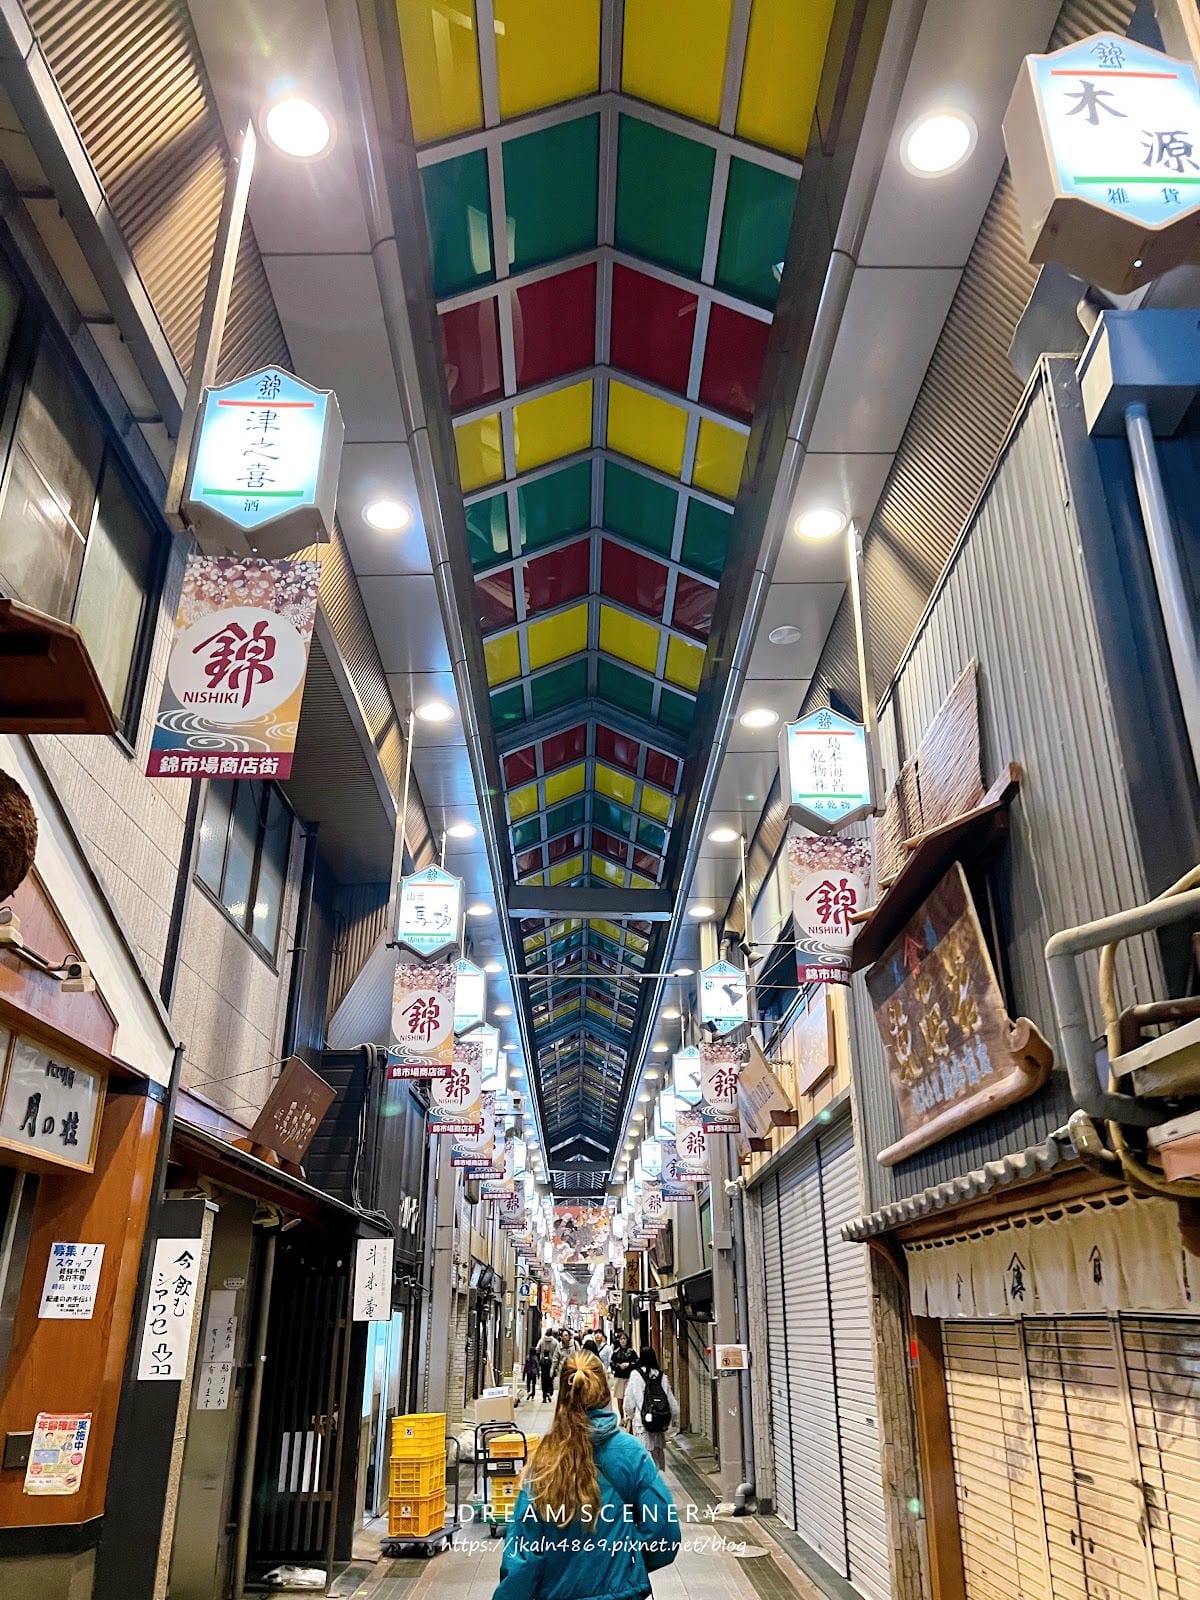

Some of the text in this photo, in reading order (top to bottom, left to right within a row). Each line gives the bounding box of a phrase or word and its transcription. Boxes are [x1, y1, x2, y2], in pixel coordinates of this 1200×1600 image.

[1090, 42, 1126, 69] 錦
[1064, 79, 1200, 173] 木源
[1108, 188, 1182, 205] 雑貨
[255, 374, 281, 400] 錦
[236, 409, 281, 489] 津之喜
[243, 498, 260, 513] 酒
[192, 619, 277, 709] 錦
[183, 690, 239, 704] NISHIKI
[159, 755, 279, 775] 錦市場商店街
[805, 878, 857, 937] 錦
[808, 926, 843, 935] NISHIKI
[402, 996, 440, 1043] 錦
[399, 1034, 426, 1042] NISHIKI
[392, 1067, 446, 1078] 錦市場商店街
[440, 1067, 470, 1105] 錦
[708, 1067, 738, 1105] 錦
[432, 1125, 476, 1133] 錦市場商店街
[682, 1131, 706, 1160] 錦
[56, 1258, 92, 1268] スタッフ
[172, 1250, 194, 1318] 今飲む
[149, 1273, 168, 1336] シアワセ
[149, 1364, 172, 1375] ココ
[38, 1420, 77, 1431] 年齢確認
[74, 1420, 88, 1450] 実施中
